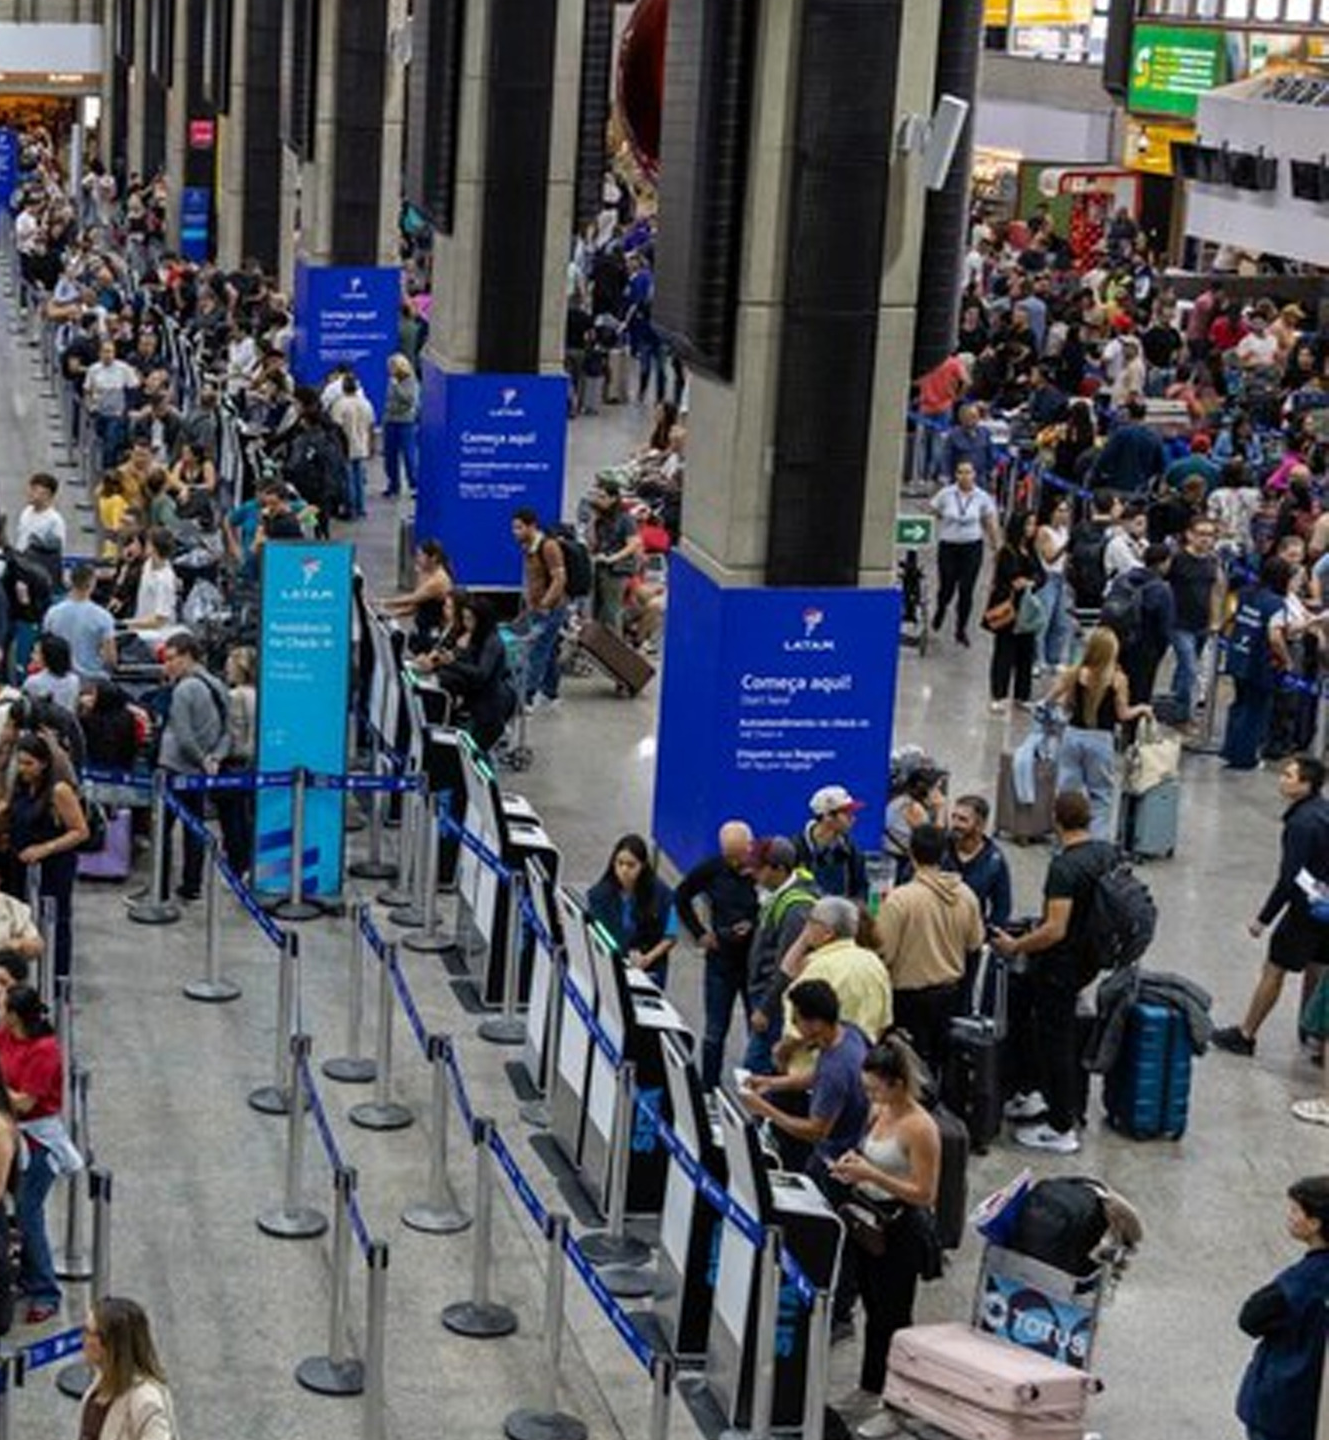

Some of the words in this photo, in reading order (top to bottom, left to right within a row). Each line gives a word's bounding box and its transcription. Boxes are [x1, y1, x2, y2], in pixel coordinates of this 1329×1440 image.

[783, 640, 835, 651] LATAM
[740, 674, 807, 694] Começa
[809, 674, 853, 694] aqui!
